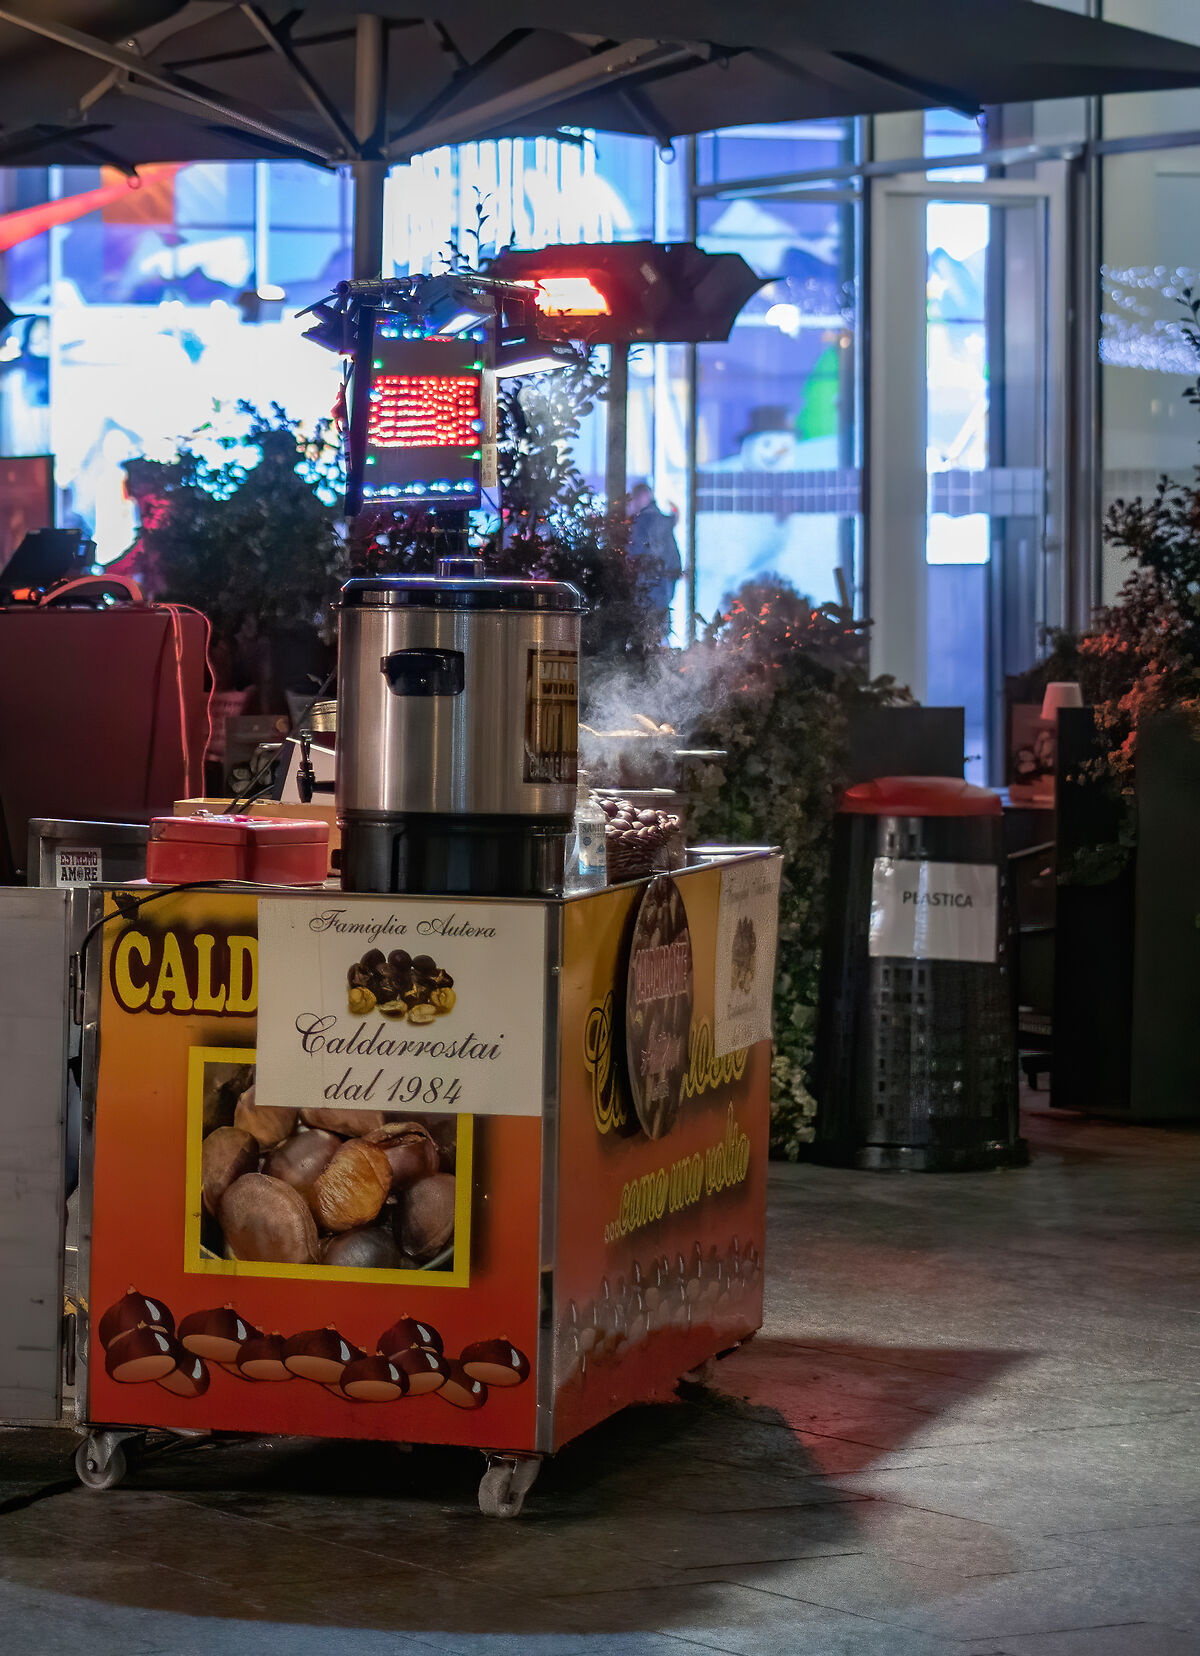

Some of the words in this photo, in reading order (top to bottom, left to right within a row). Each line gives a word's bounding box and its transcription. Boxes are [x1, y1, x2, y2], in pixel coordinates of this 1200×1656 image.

[60, 867, 98, 881] AMORE
[902, 890, 973, 908] PLASTICA
[308, 908, 408, 943] Famiglia
[416, 913, 497, 940] Autera
[294, 1012, 505, 1062] Caldarrostai
[323, 1067, 380, 1102] dal
[386, 1075, 463, 1105] 1984
[667, 1151, 704, 1213] una
[705, 1100, 750, 1196] volta
